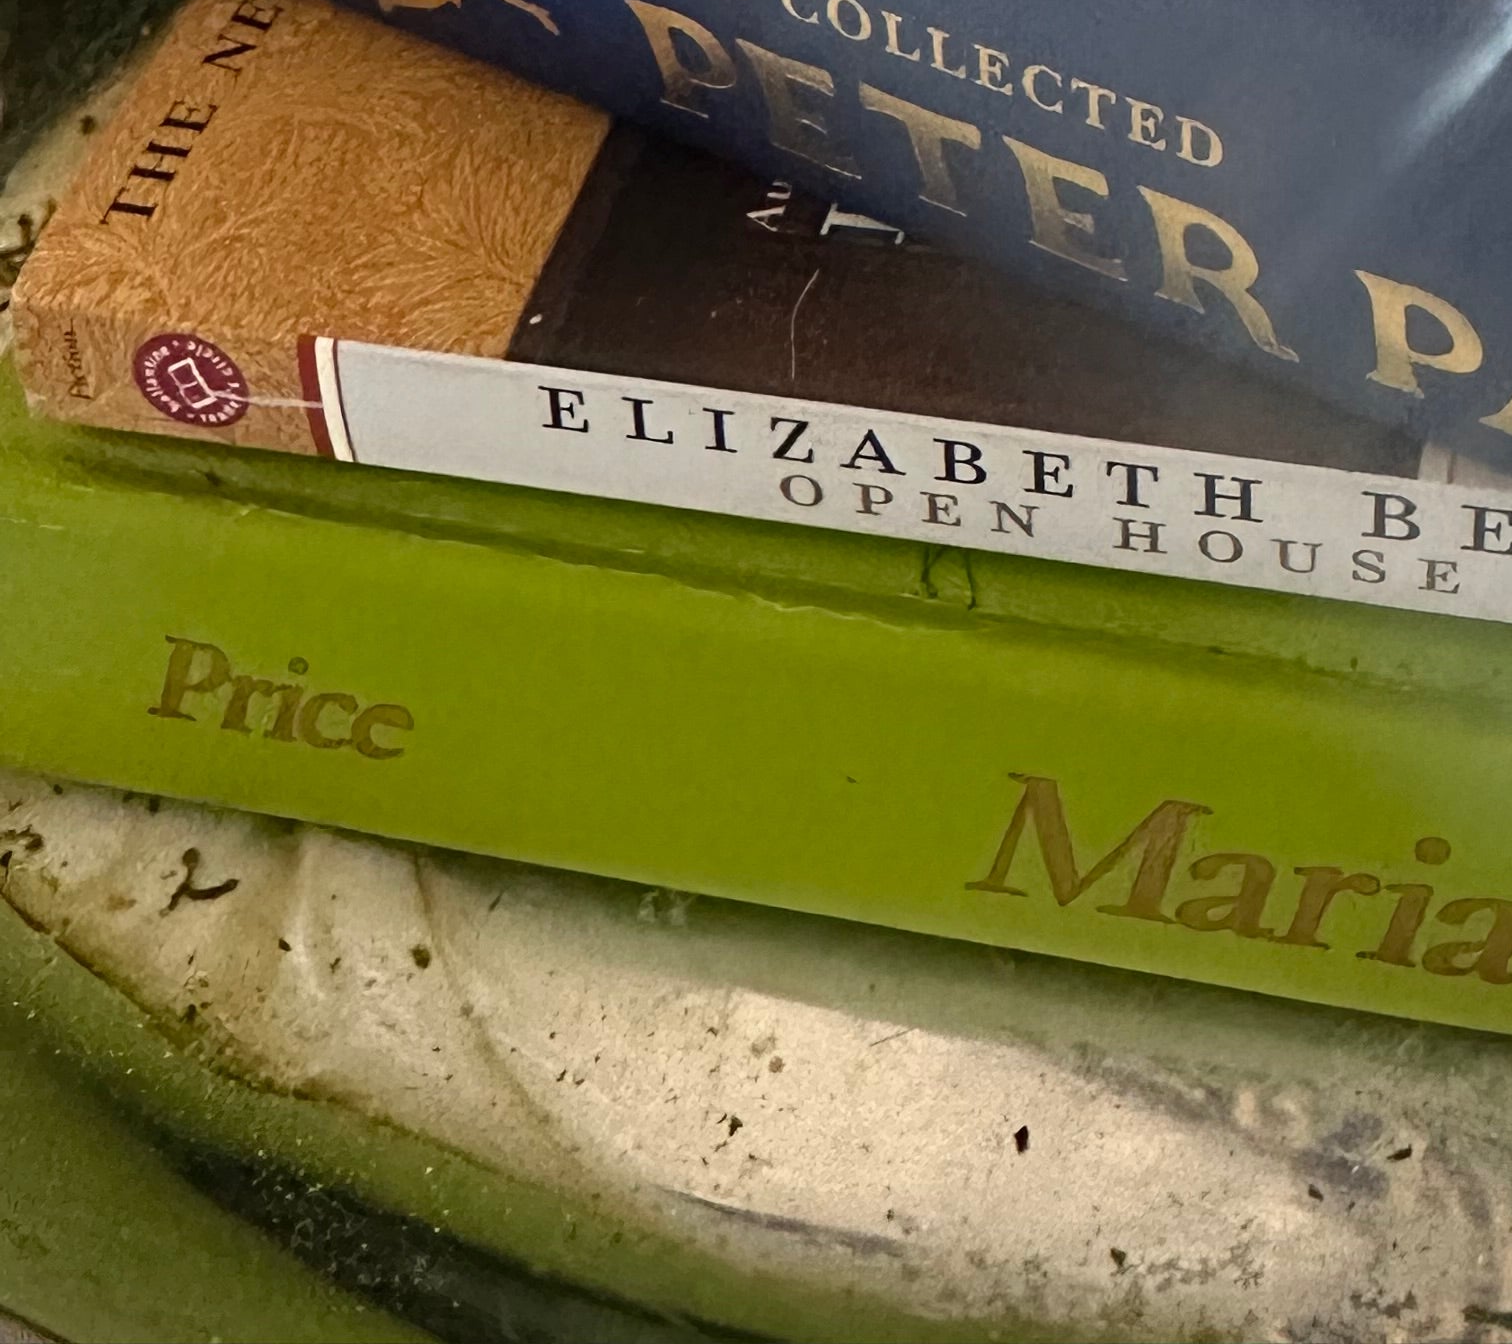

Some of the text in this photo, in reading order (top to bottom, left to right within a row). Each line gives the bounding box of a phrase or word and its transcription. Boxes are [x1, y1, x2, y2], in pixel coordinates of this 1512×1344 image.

[98, 98, 219, 226] THE
[537, 384, 1264, 525] ELIZABETH
[778, 473, 1460, 596] OPEN HOUSE
[146, 633, 416, 761] Price
